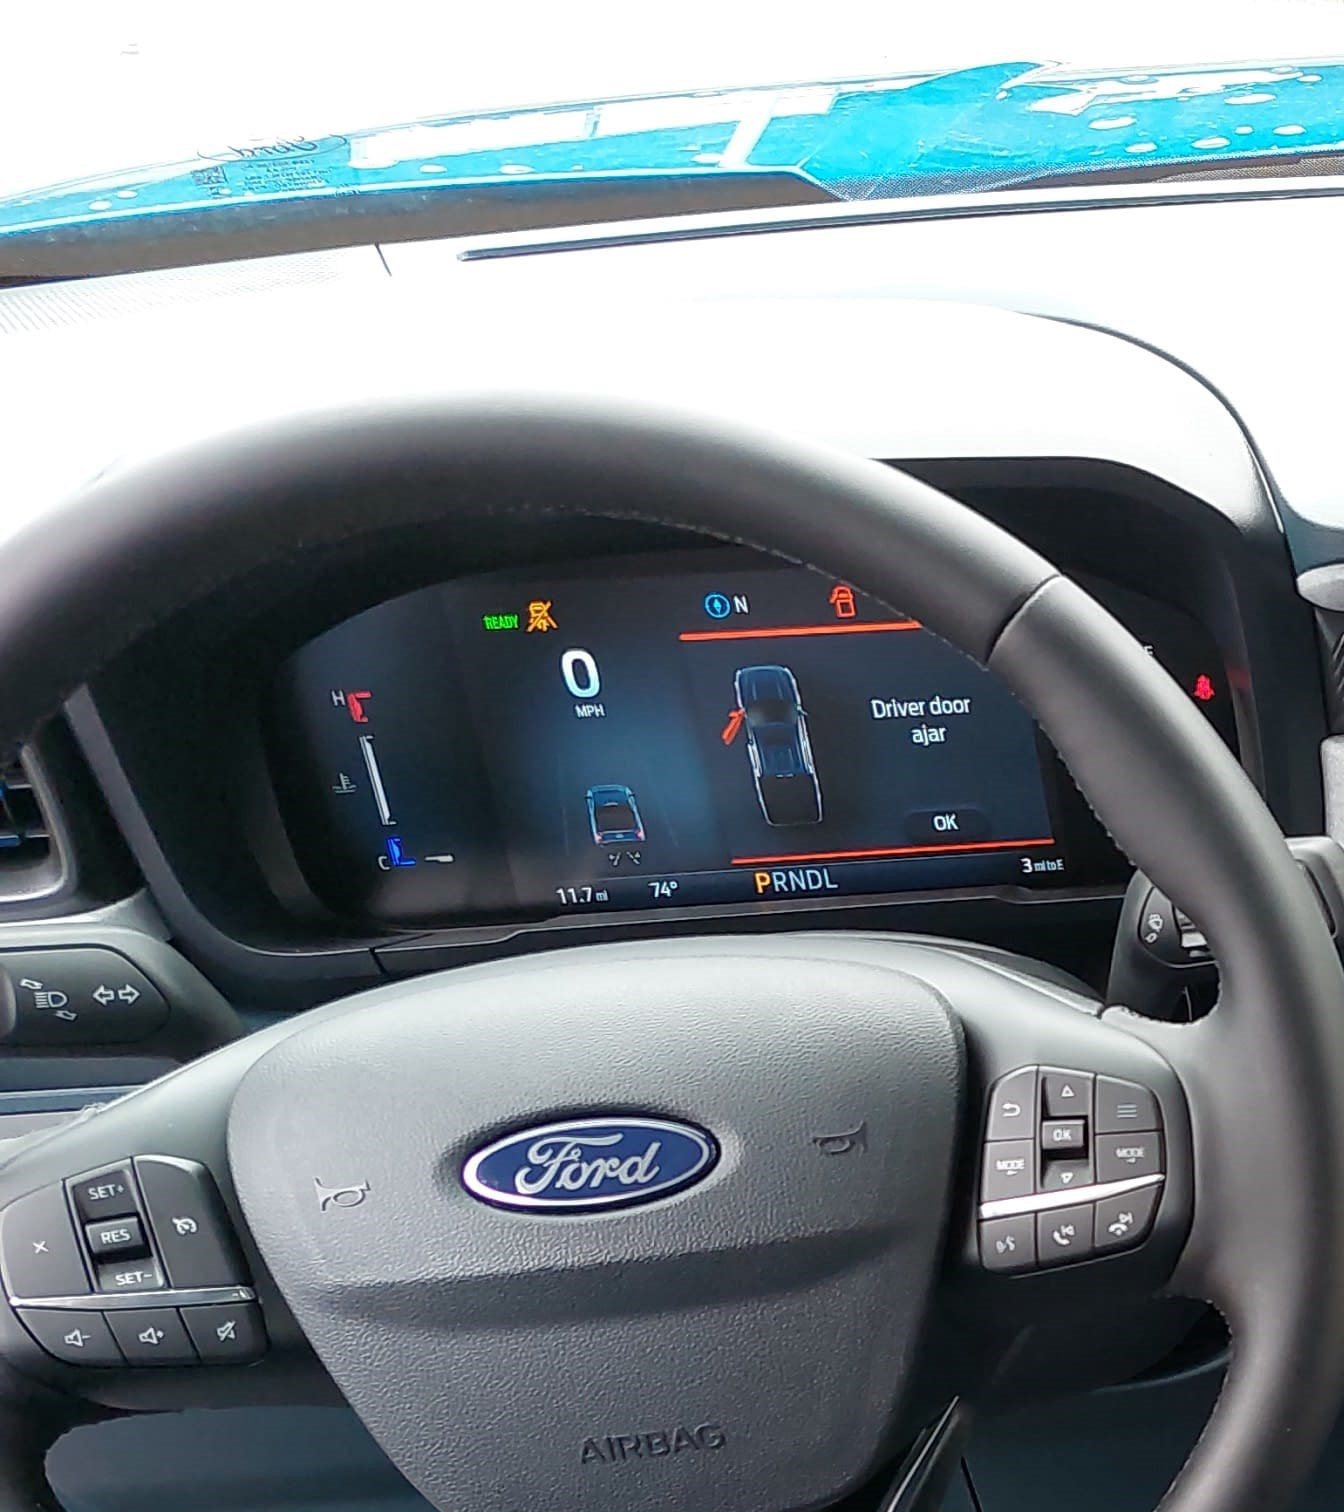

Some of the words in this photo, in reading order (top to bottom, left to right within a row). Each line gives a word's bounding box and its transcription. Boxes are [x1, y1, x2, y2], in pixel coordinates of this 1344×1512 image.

[733, 596, 749, 614] N
[483, 614, 519, 630] READY
[560, 648, 601, 698] 0
[575, 704, 605, 718] MPH
[871, 698, 926, 719] Driver
[930, 695, 971, 714] door
[910, 725, 947, 748] ajar
[934, 814, 959, 831] OK
[1021, 858, 1033, 873] 3
[753, 868, 838, 894] PRNDL
[556, 887, 593, 904] 11.7
[648, 881, 678, 899] 74°
[1052, 1129, 1072, 1141] OK
[1116, 1147, 1144, 1159] MODE
[514, 1132, 660, 1195] Ford
[996, 1158, 1025, 1171] MODE
[101, 1229, 130, 1244] RES
[580, 1424, 725, 1465] AIRBAG
